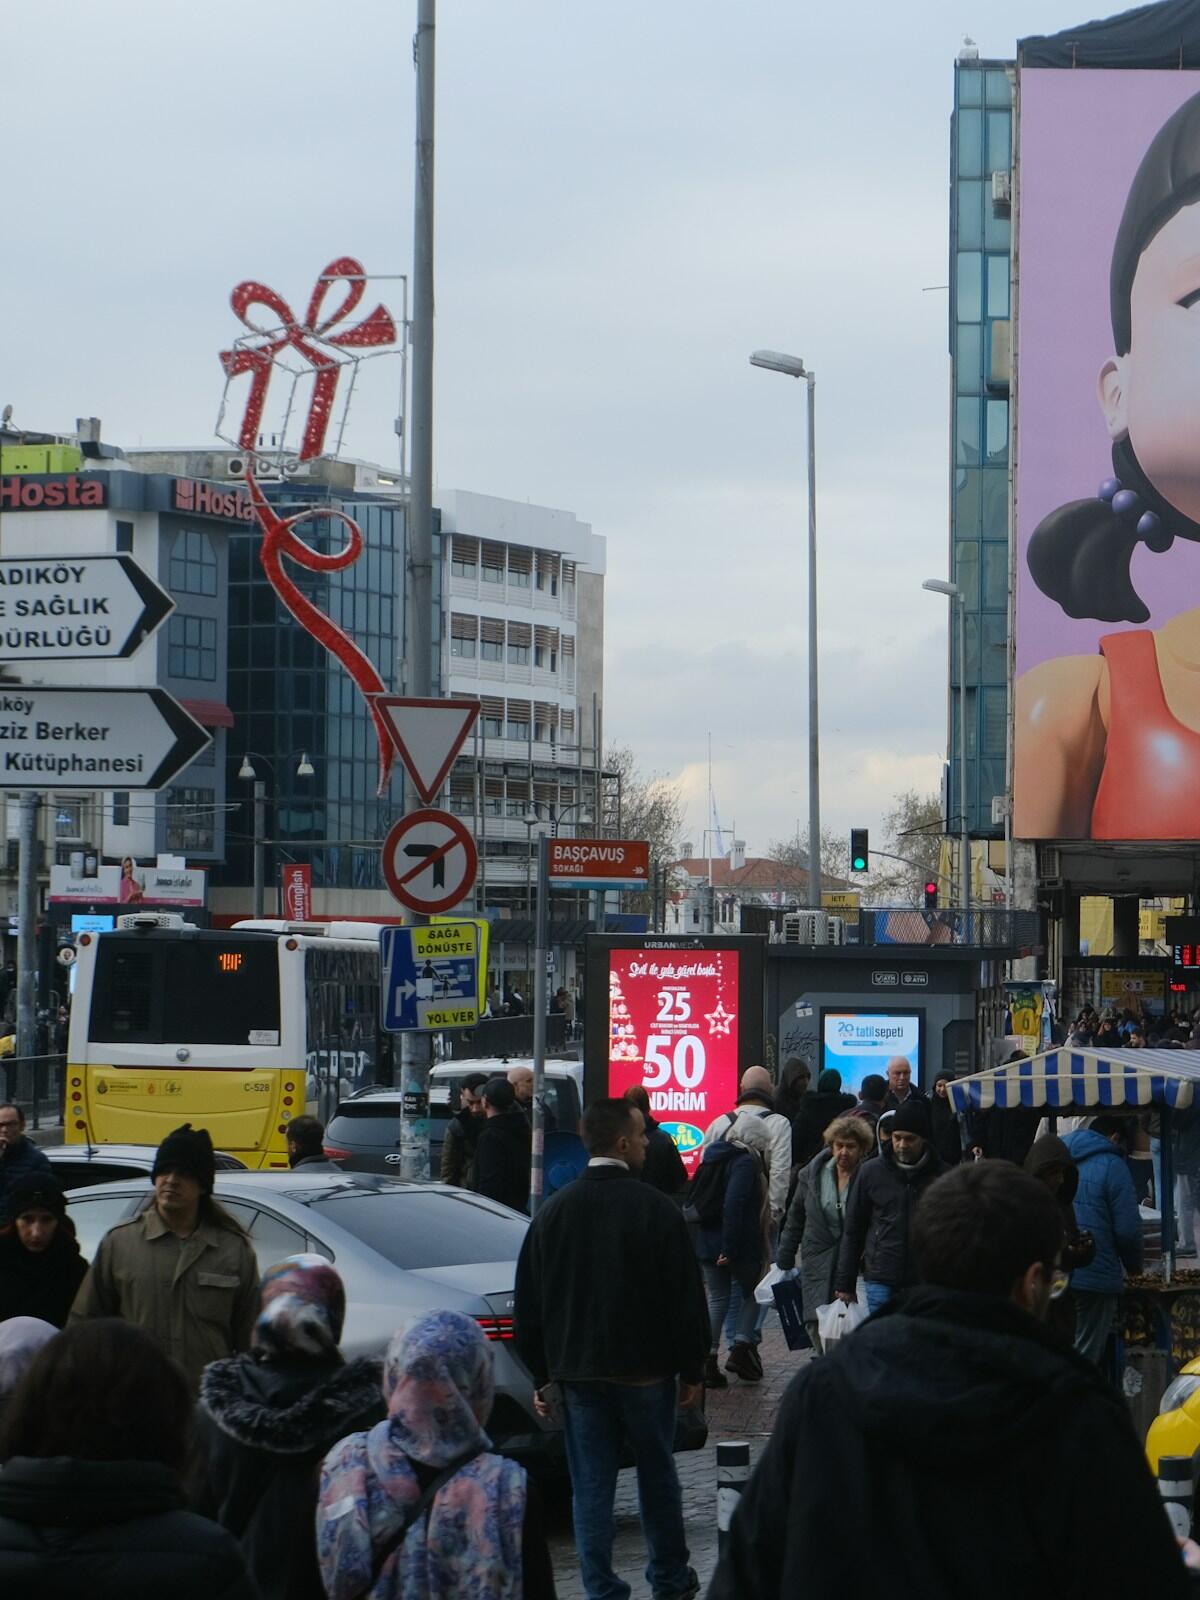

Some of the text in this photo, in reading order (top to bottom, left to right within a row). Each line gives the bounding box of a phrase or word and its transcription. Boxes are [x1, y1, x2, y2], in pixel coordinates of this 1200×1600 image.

[0, 476, 104, 507] Hosta
[195, 480, 257, 521] Hosta
[0, 563, 86, 585] DIKÖY
[15, 595, 110, 616] SAĞLIK
[0, 626, 111, 648] ÜRLÜĞÜ
[0, 721, 110, 740] ziz Berker
[5, 752, 143, 775] Kütüphanesi
[554, 845, 625, 863] BAŞÇAVUŞ
[552, 864, 584, 873] SOKAĞI
[427, 927, 460, 939] SAĞA
[417, 942, 473, 954] DÖNÜŞTE
[427, 1011, 474, 1025] YOL VER
[648, 1088, 706, 1112] NDİRİM
